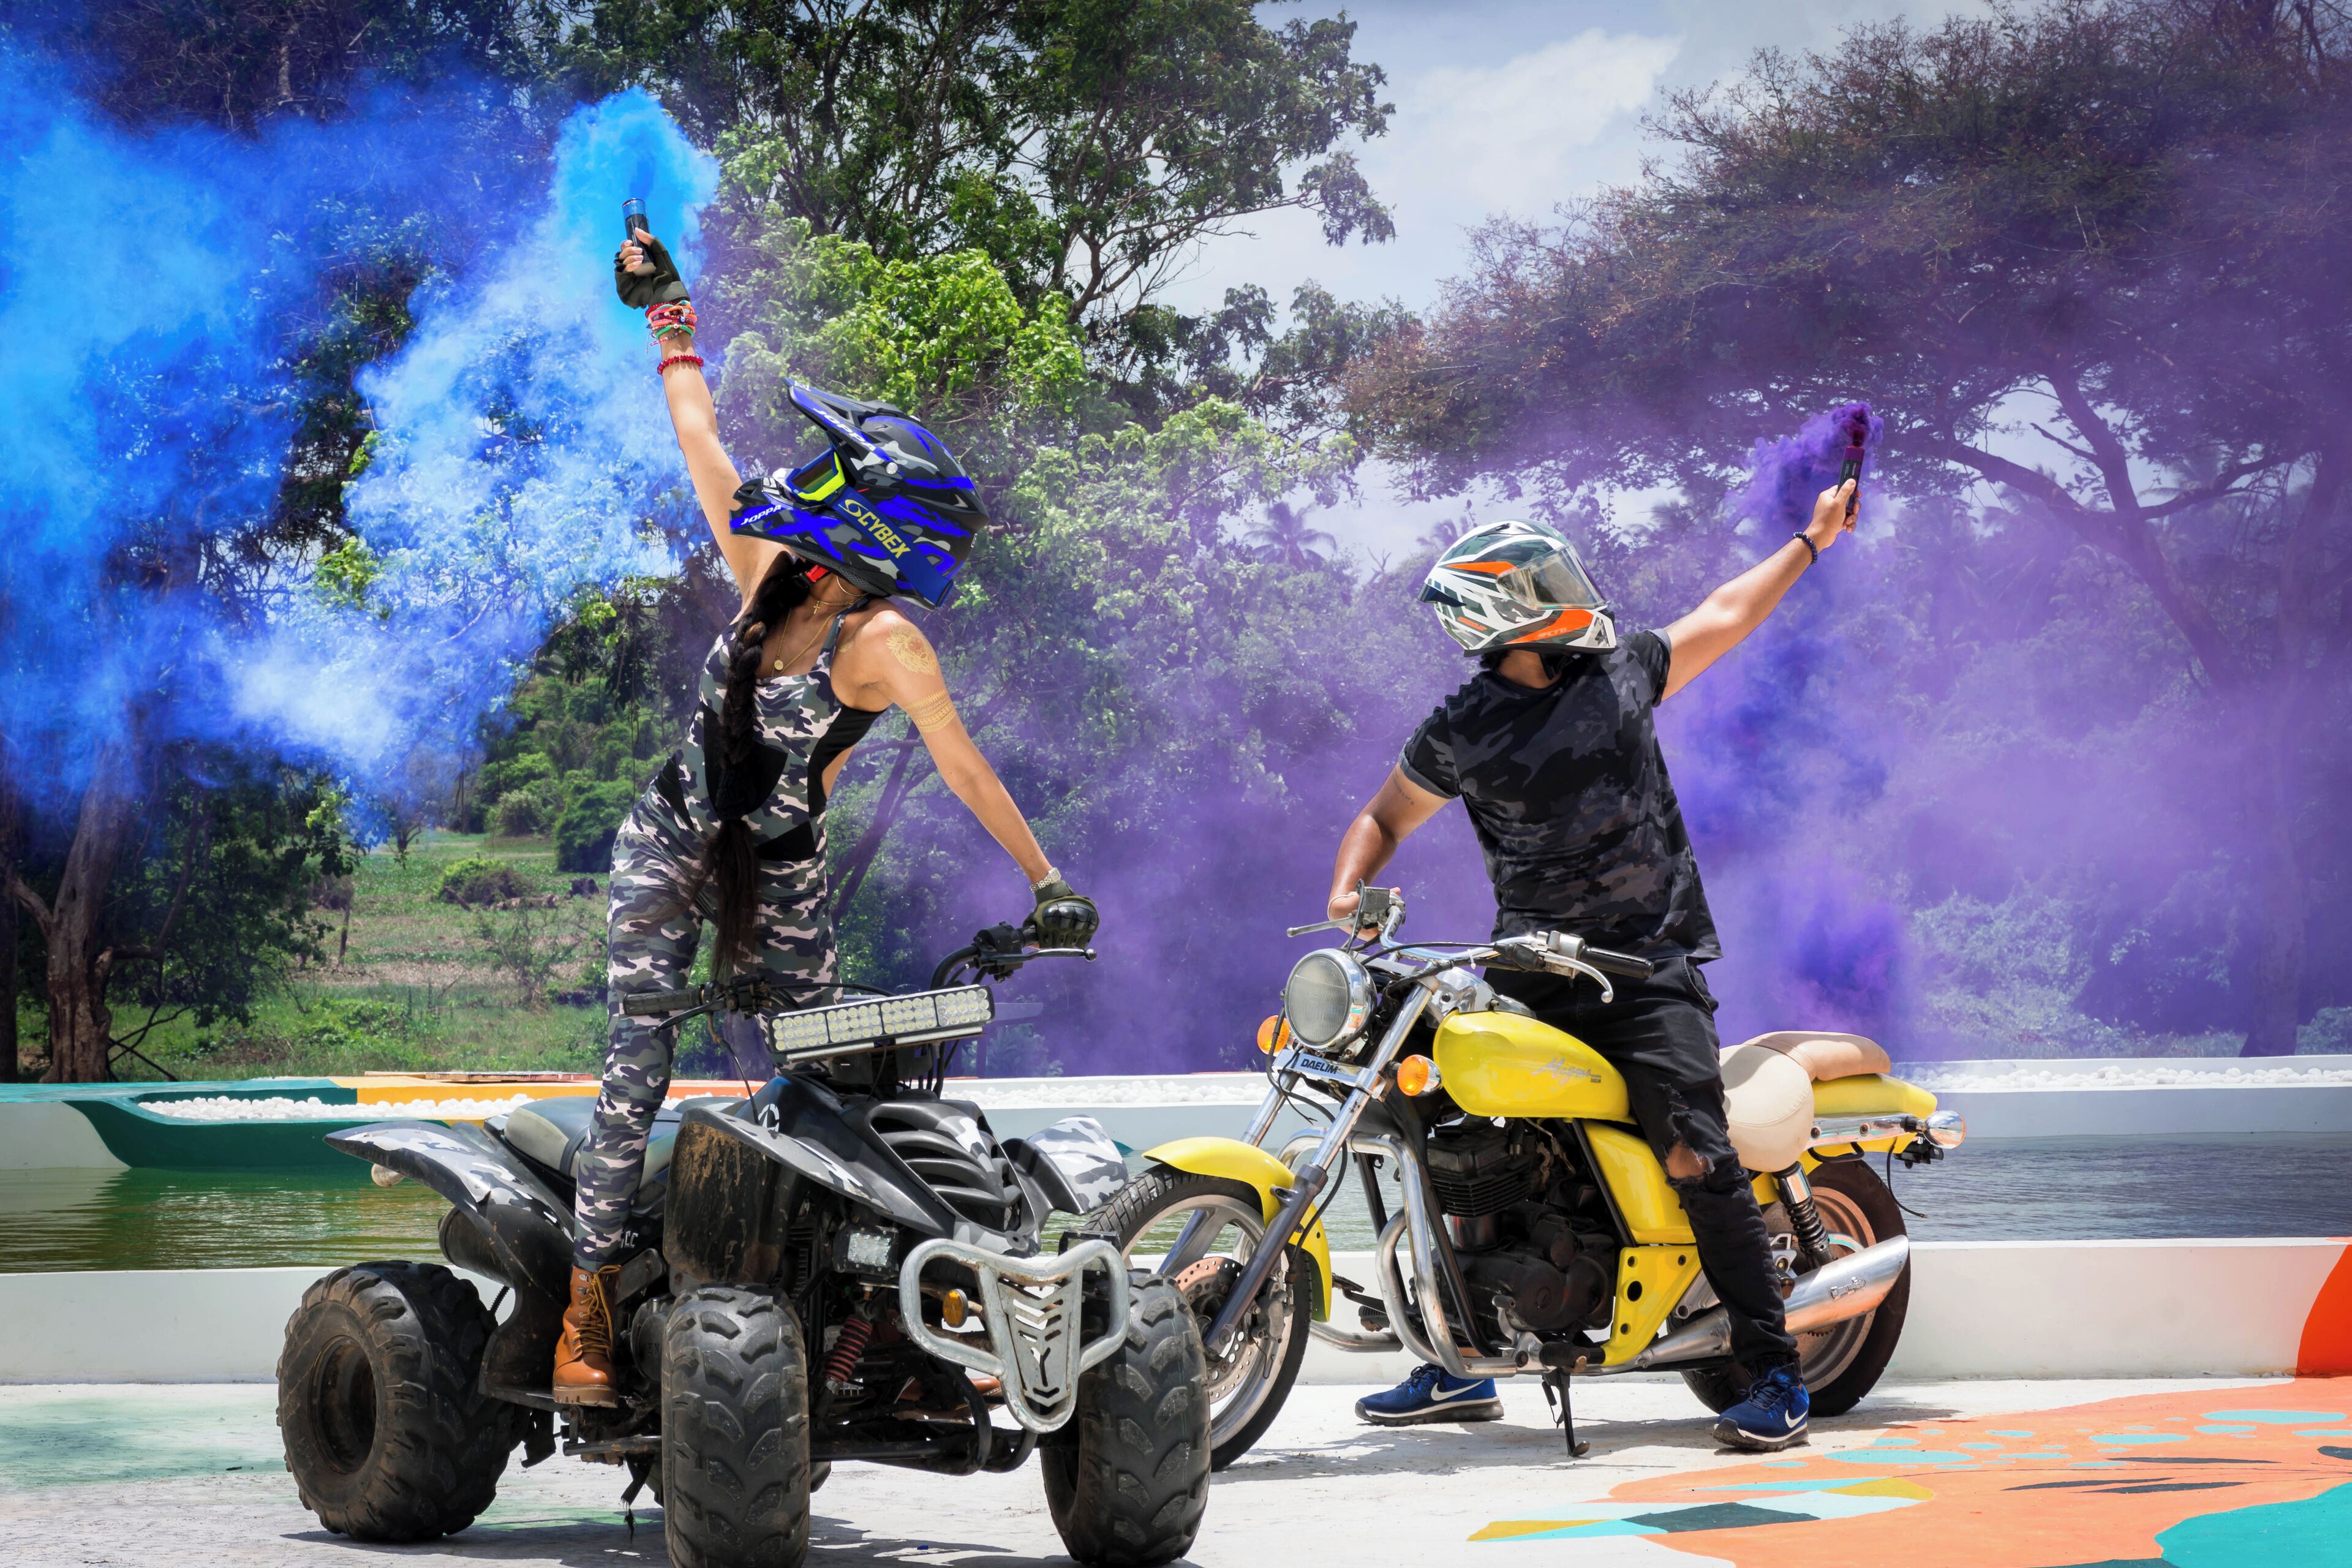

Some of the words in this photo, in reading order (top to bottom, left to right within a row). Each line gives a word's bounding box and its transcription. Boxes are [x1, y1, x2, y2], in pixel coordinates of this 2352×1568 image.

[813, 407, 876, 451] JOPPA
[741, 504, 782, 526] JOPPA
[858, 511, 911, 559] CYBEX
[1300, 1058, 1339, 1074] DAELIM
